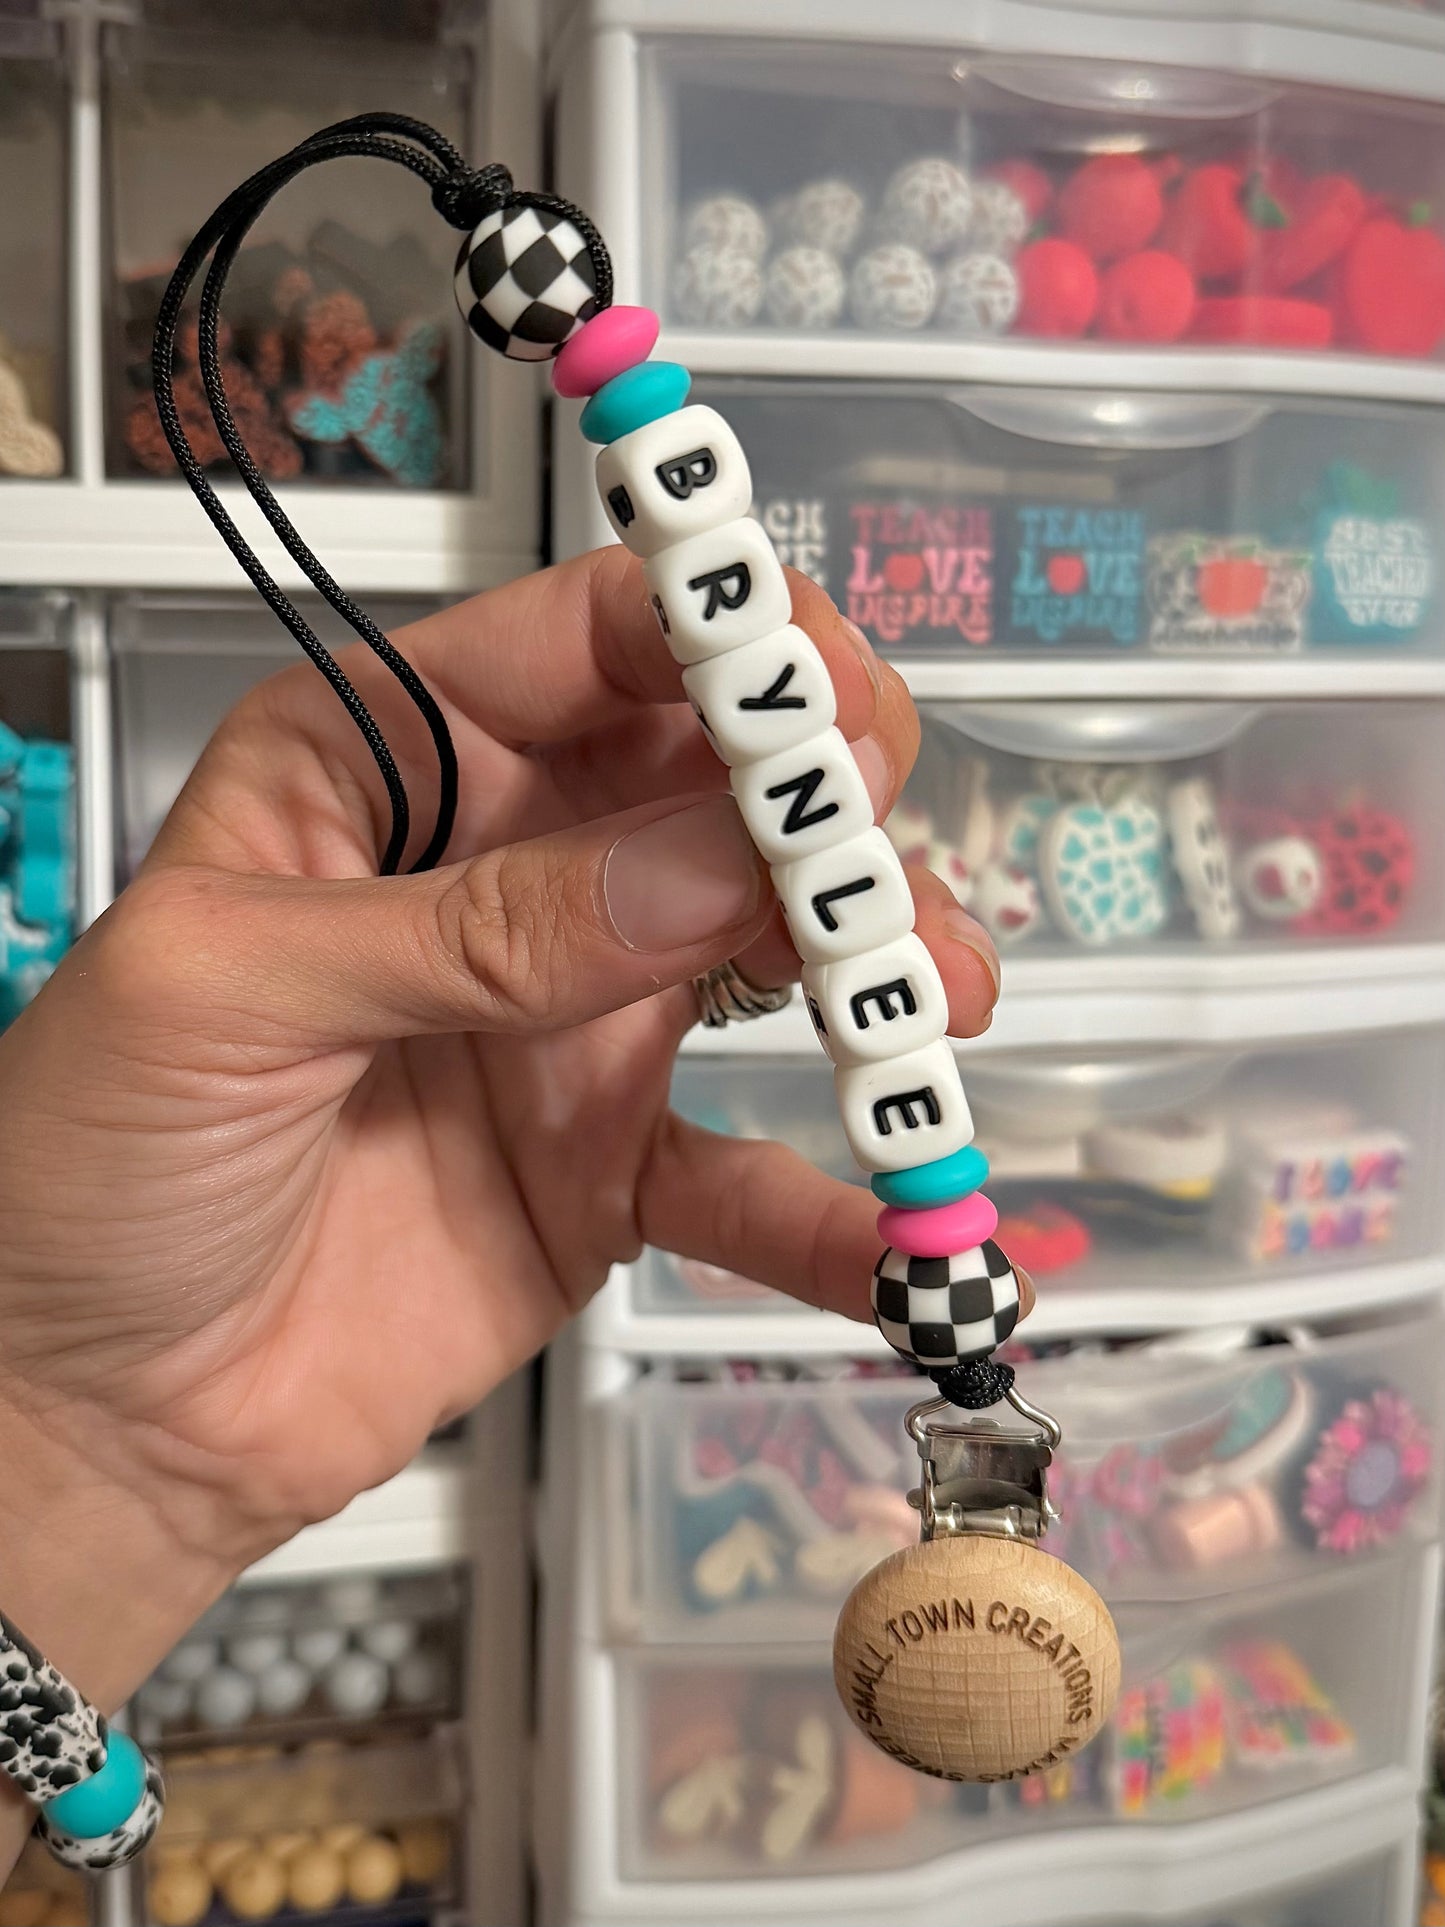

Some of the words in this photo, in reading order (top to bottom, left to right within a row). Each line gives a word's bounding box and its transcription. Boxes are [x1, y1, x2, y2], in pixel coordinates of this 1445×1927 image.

[848, 504, 991, 547] TEACH
[1016, 508, 1145, 549] TEACH
[847, 592, 992, 644] INSPIRE
[1011, 594, 1140, 642] INSPIRE
[655, 446, 942, 1136] BRYNLEE
[852, 1642, 893, 1726] SMALL
[885, 1598, 975, 1648] TOWN
[986, 1601, 1093, 1724] CREATIONS
